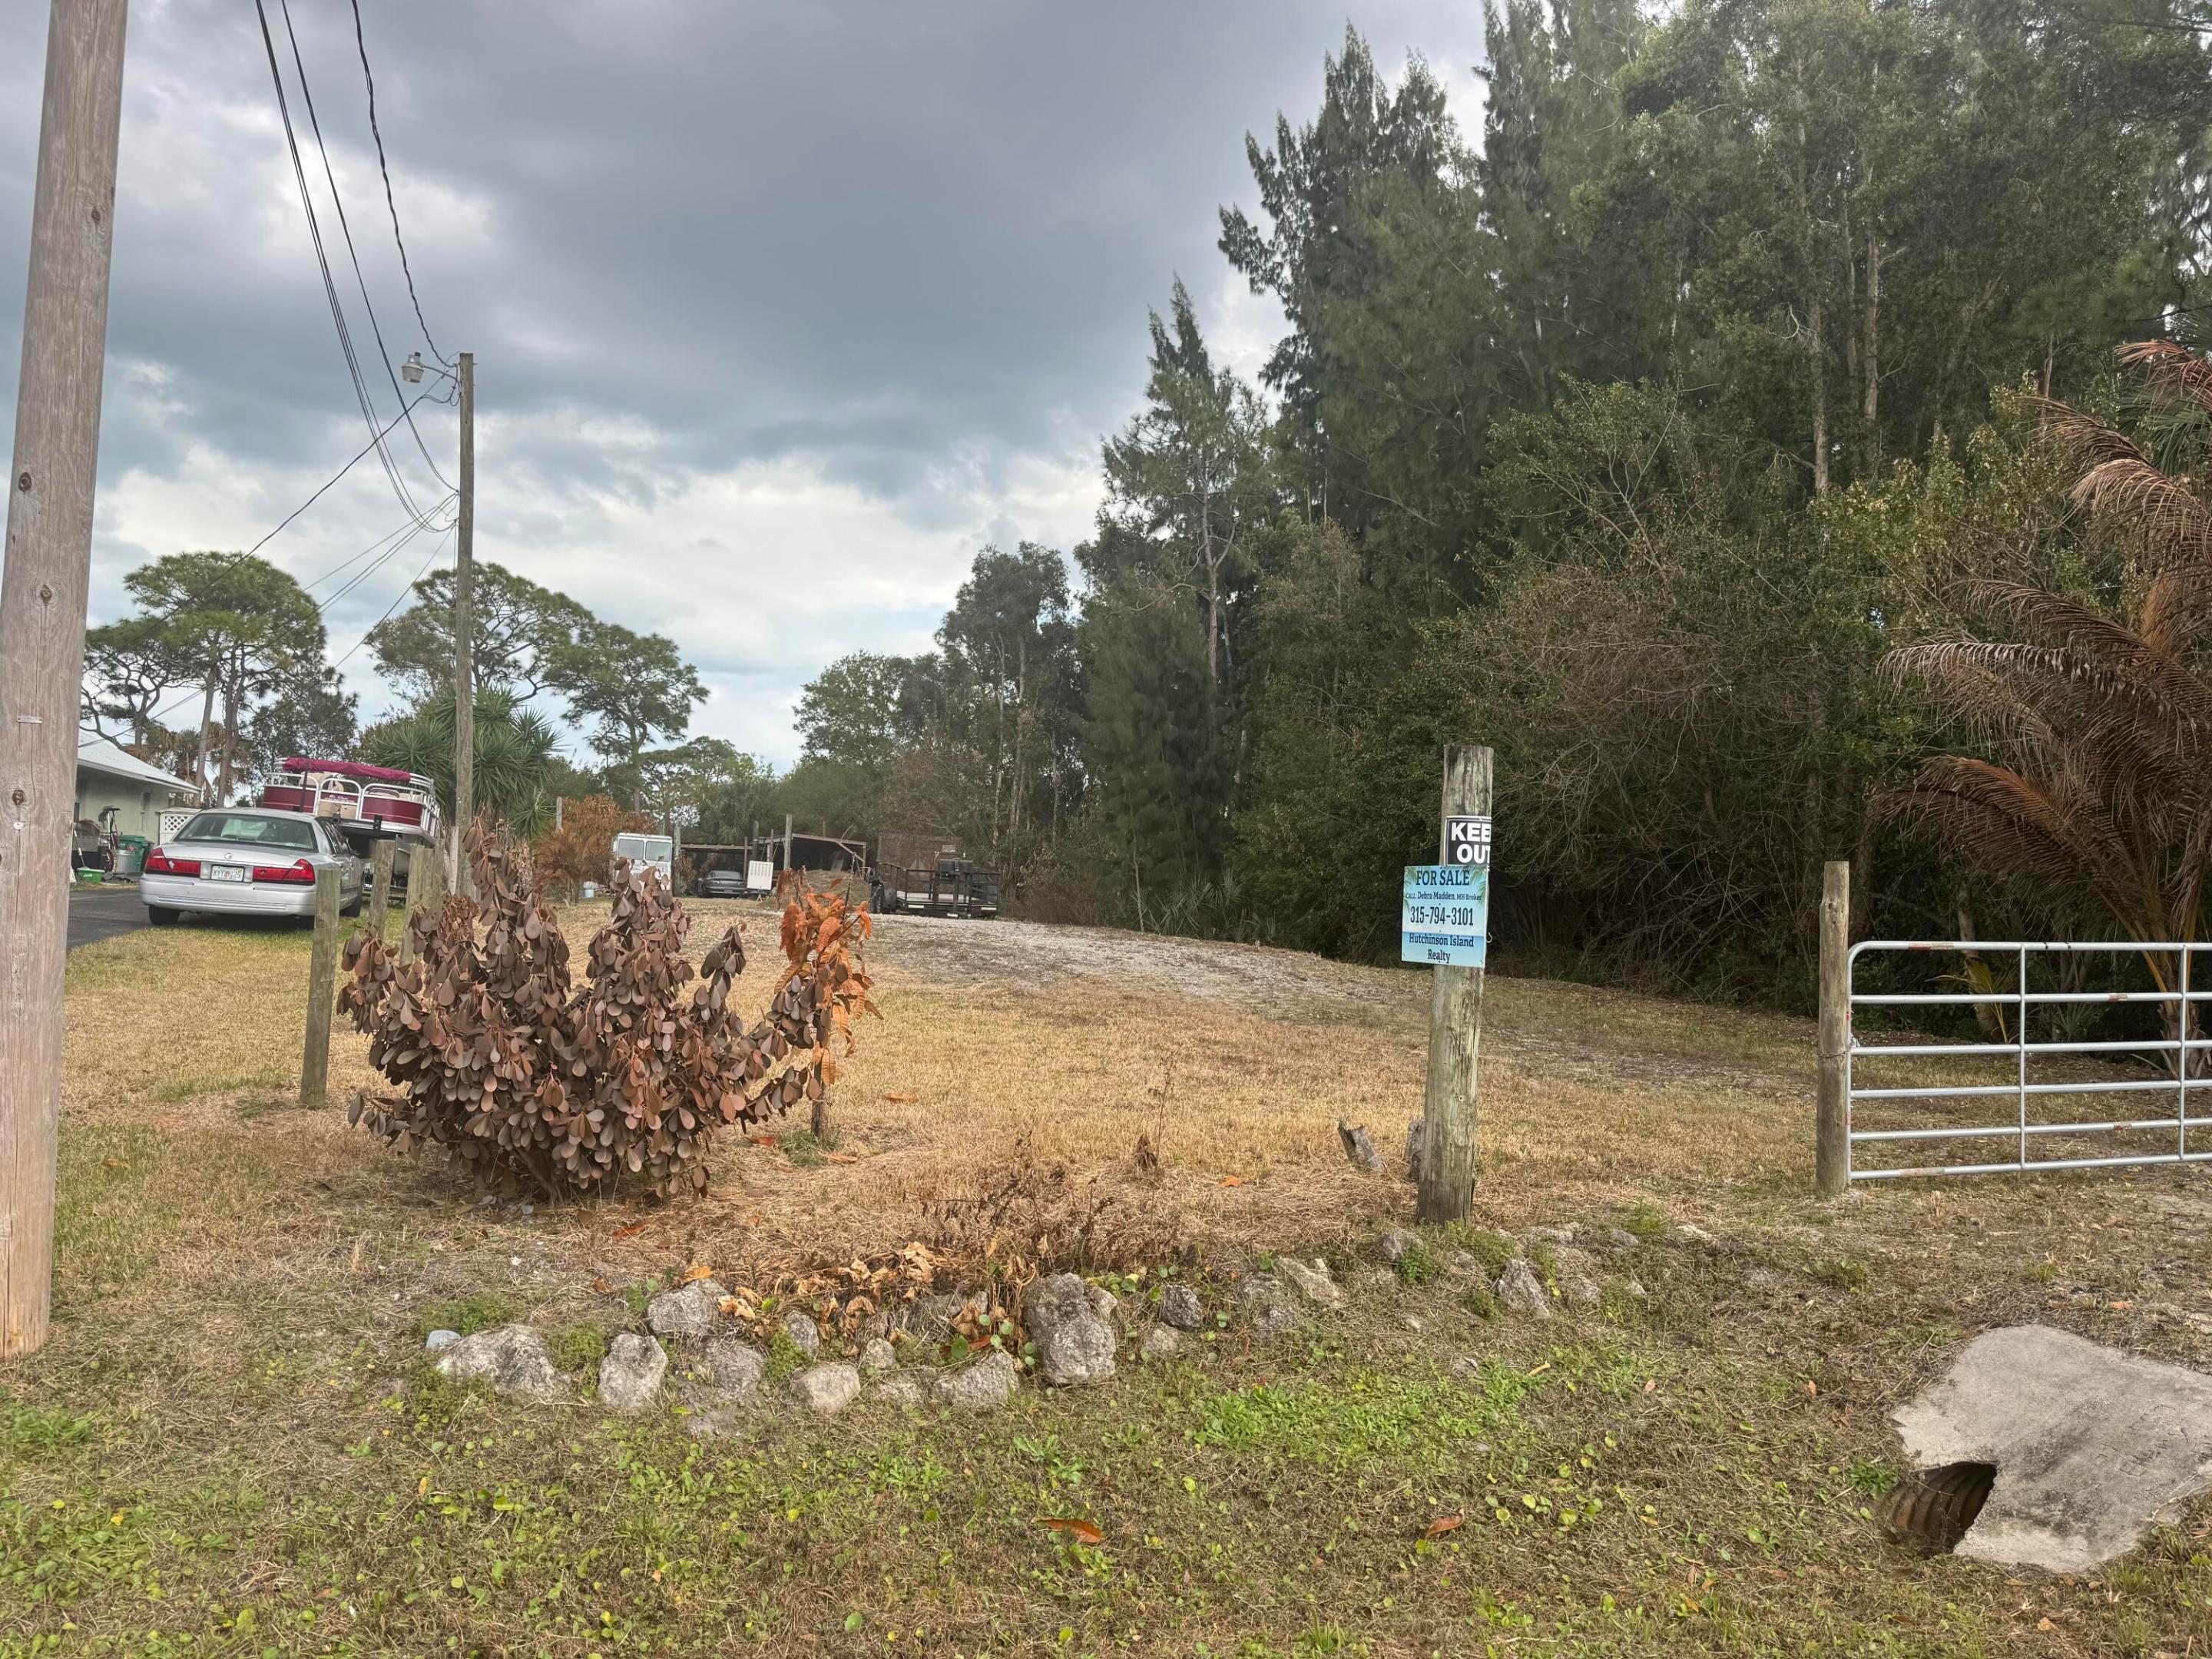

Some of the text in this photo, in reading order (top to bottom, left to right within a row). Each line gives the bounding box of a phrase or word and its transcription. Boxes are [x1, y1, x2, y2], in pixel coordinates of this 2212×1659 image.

[1416, 869, 1470, 886] FOR SALE
[1417, 891, 1432, 899] Debra
[1410, 906, 1474, 926] 315-794-3101
[1409, 932, 1474, 948] Hutchinson Island
[1427, 949, 1451, 964] Realty
